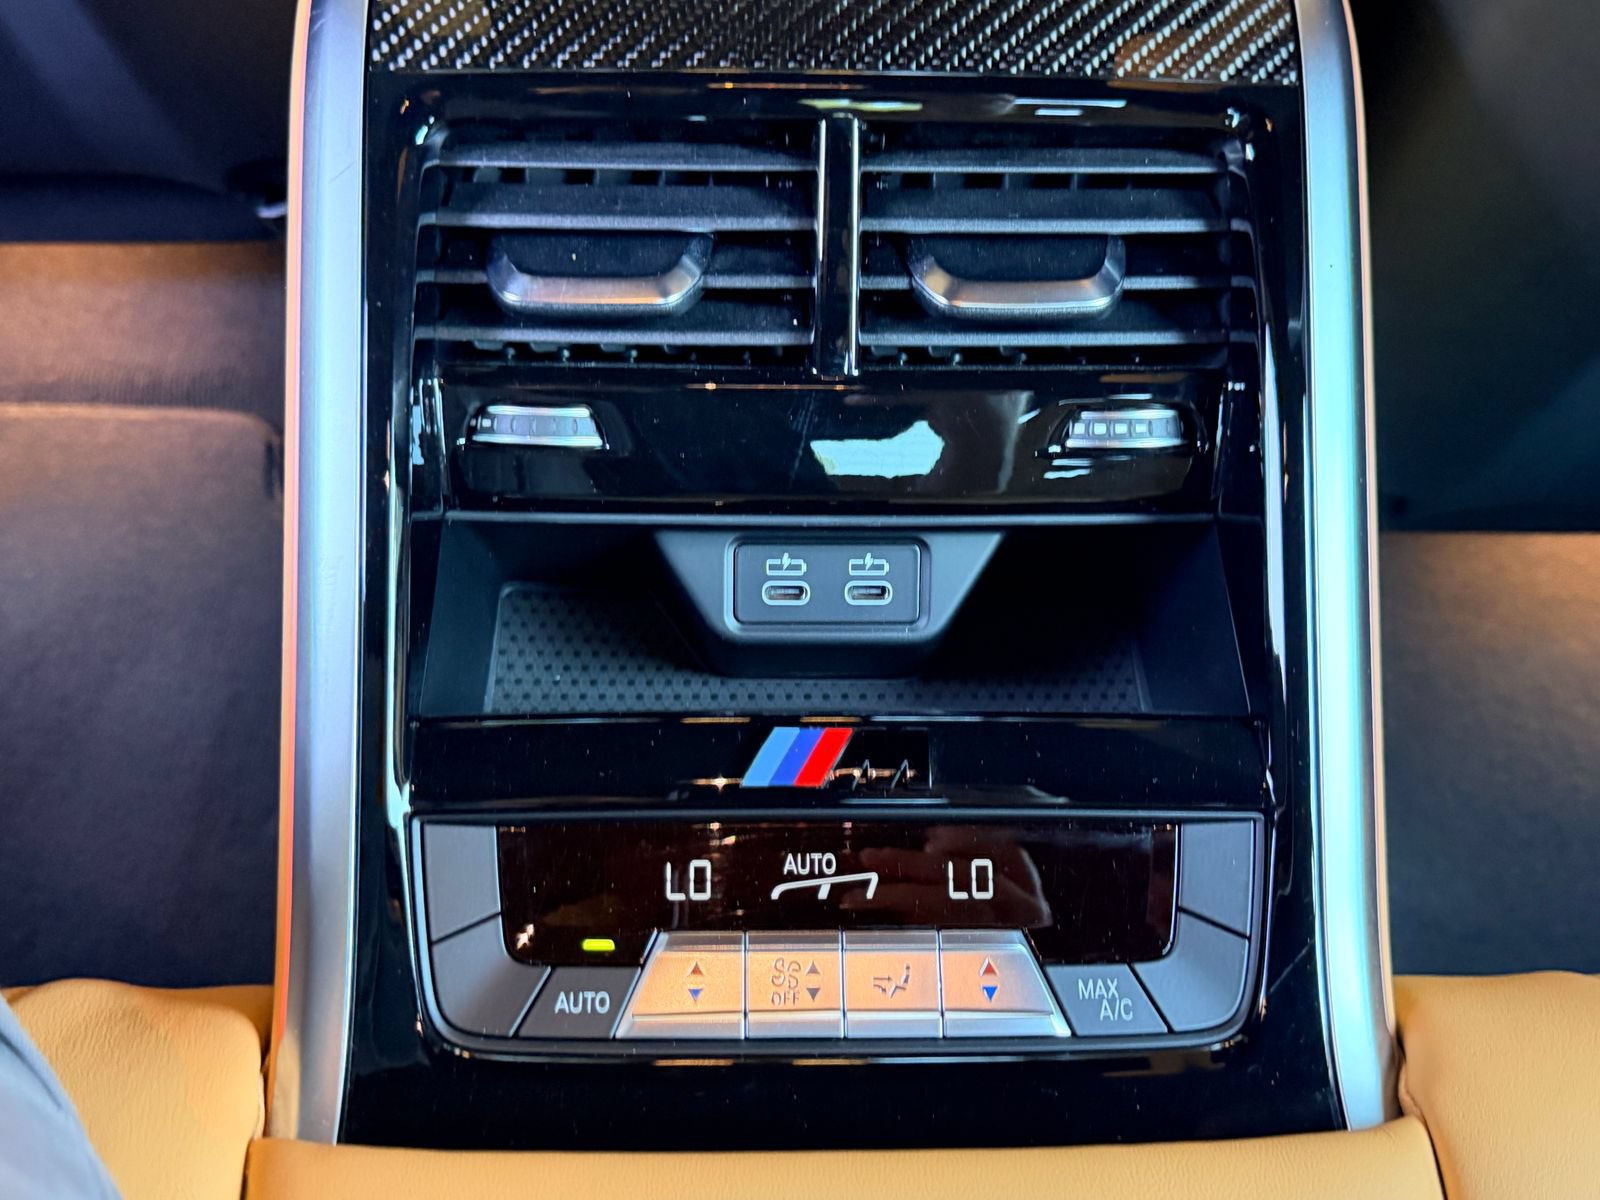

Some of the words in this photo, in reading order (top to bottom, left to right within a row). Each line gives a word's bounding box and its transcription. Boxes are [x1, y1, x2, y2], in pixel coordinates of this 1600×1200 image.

[783, 852, 837, 875] AUTO
[665, 859, 712, 901] LO
[948, 858, 994, 900] LO
[771, 991, 800, 1006] OFF
[1078, 978, 1119, 1000] MAX
[554, 991, 611, 1014] AUTO
[1100, 998, 1133, 1021] A/C
